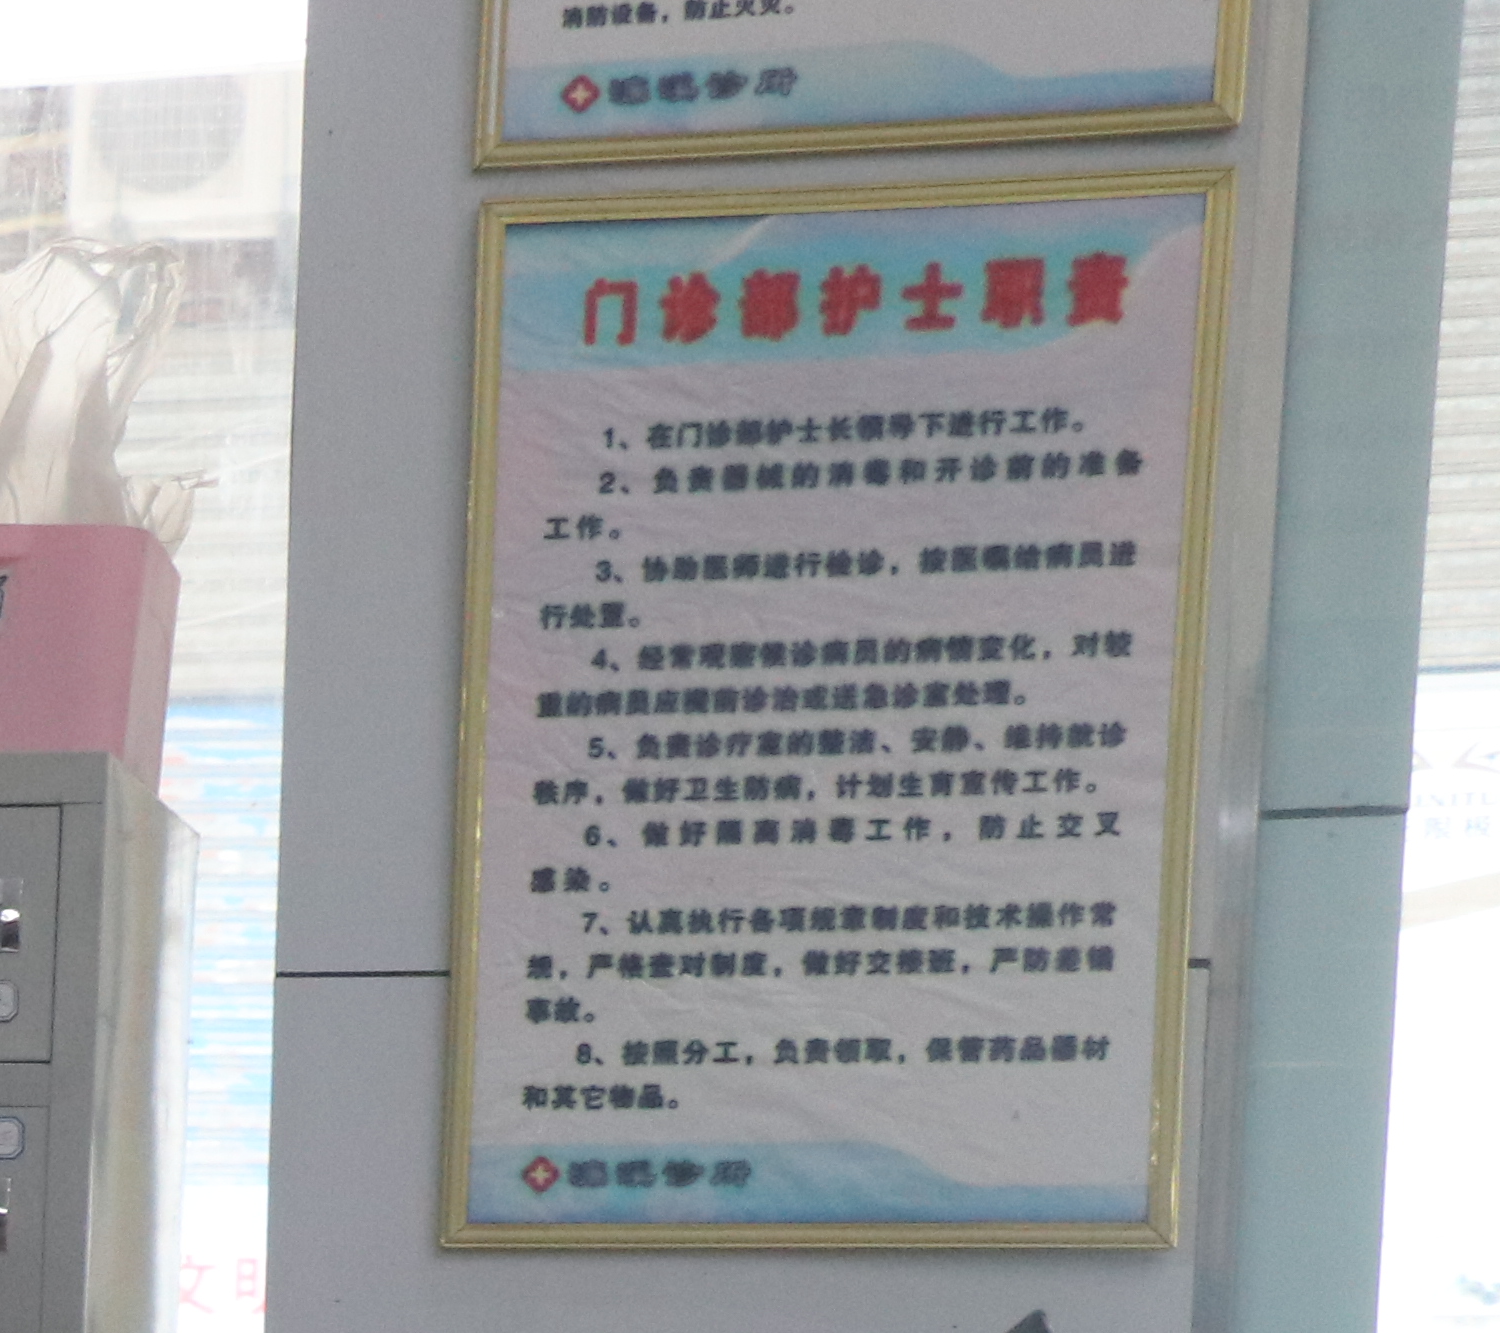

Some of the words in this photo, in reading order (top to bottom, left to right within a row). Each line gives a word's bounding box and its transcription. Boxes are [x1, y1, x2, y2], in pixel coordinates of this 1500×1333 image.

[582, 251, 1130, 346] 门诊部护士职责
[544, 514, 621, 541] 工作。
[540, 601, 640, 631] 行处置。
[530, 866, 610, 894] 感染。
[525, 996, 596, 1024] 事故。
[522, 1084, 679, 1110] 和其它物品。
